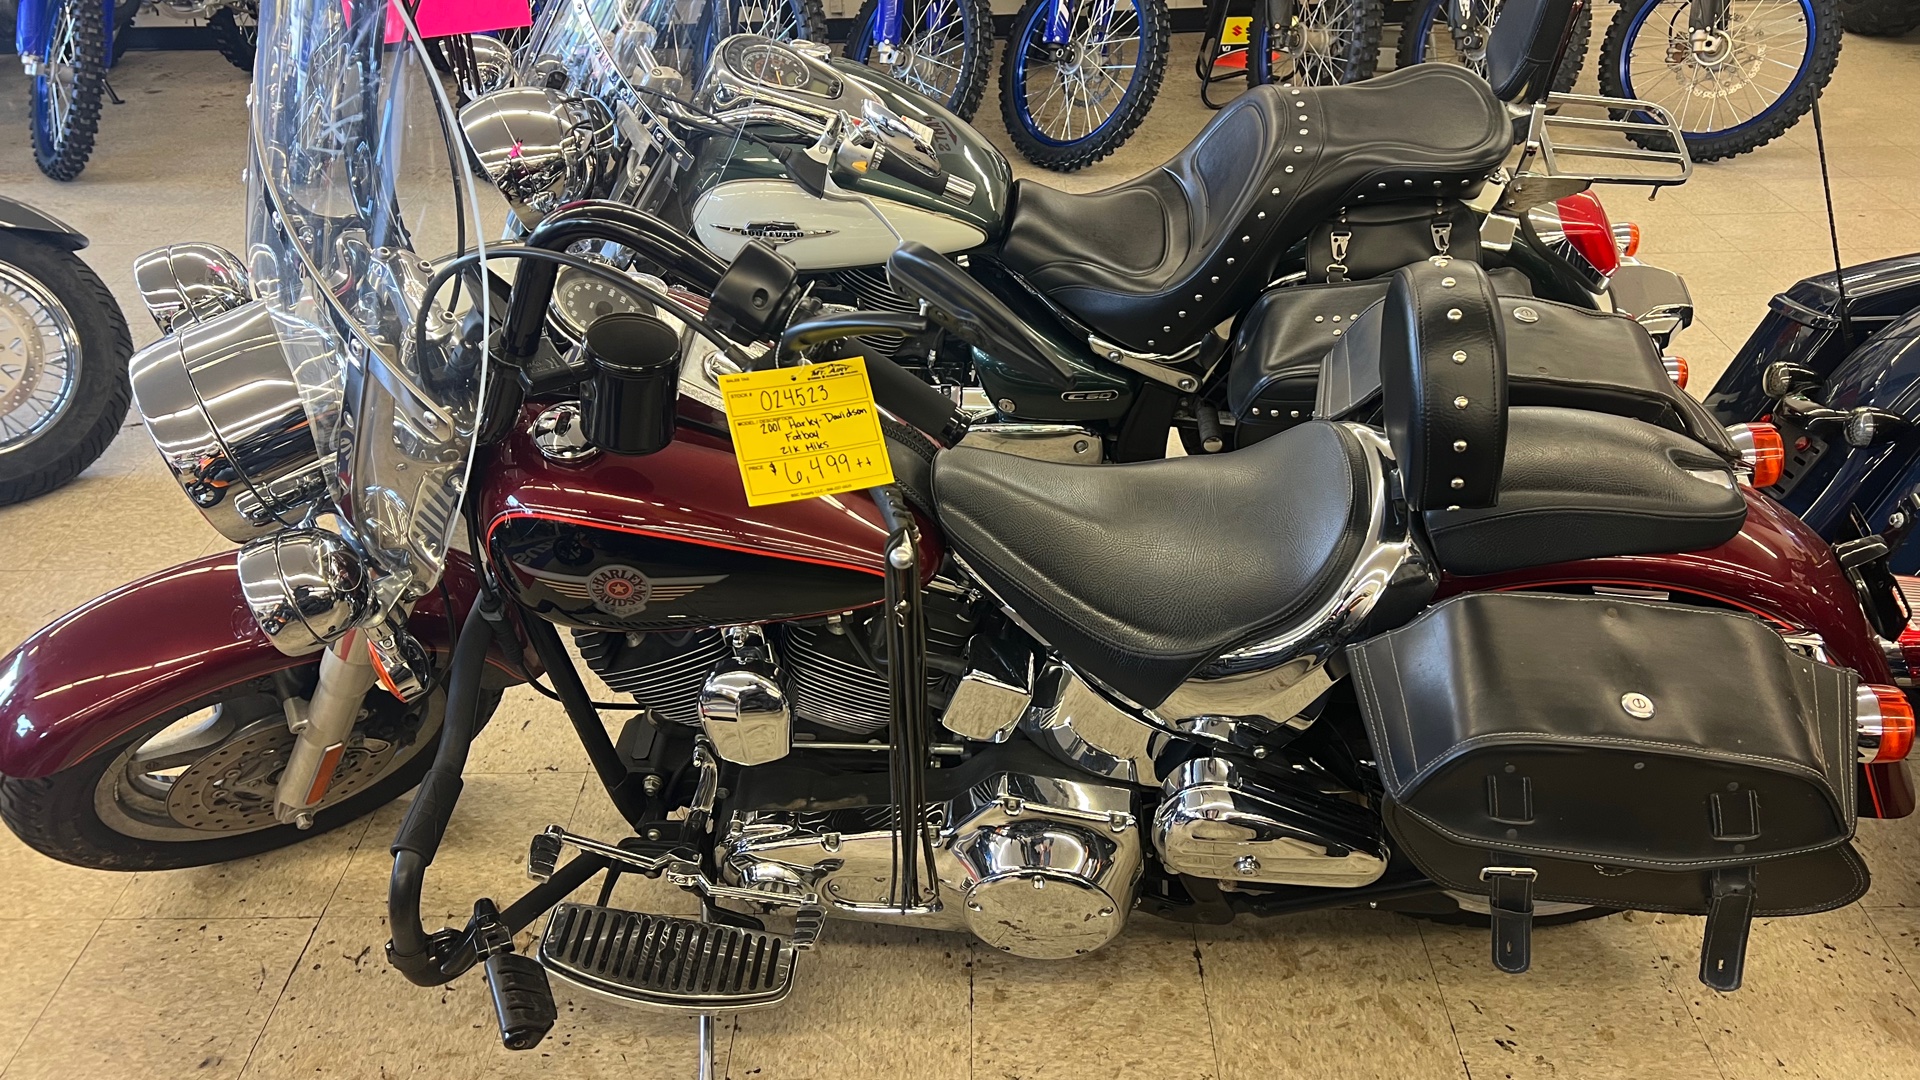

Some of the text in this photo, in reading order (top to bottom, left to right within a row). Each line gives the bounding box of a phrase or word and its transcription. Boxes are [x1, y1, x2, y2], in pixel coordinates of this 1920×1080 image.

[740, 229, 804, 239] BOULEVARD
[760, 385, 829, 411] 024523
[760, 420, 781, 435] 2001
[785, 430, 820, 442] Fatboy
[592, 569, 647, 587] HARLEY
[592, 588, 647, 607] DAVIDSON
